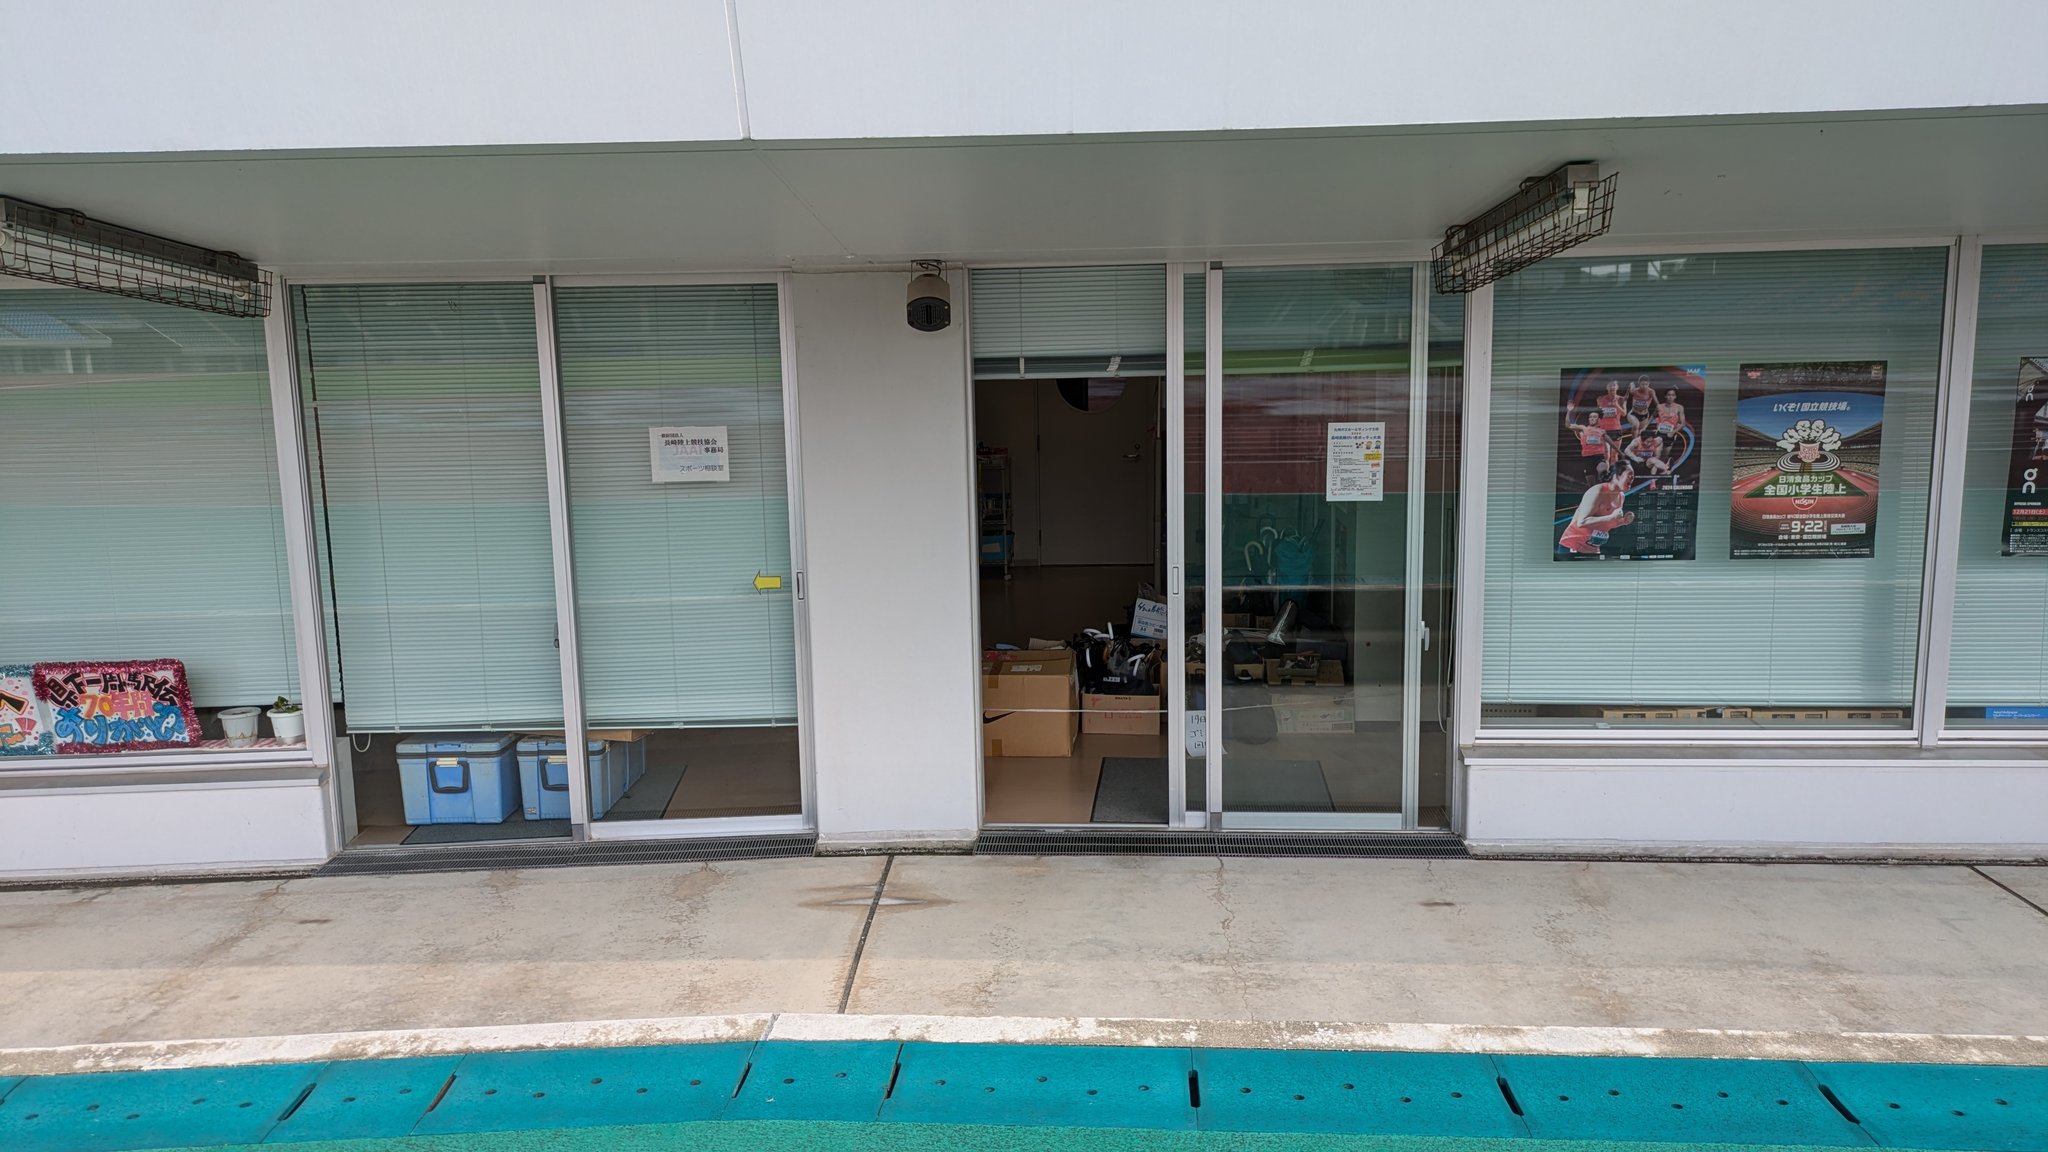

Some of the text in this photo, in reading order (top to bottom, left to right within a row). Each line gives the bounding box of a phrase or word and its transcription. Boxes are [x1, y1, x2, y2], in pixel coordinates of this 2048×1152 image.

[680, 464, 724, 472] スポーツ相談室
[1779, 475, 1833, 484] 日清食品カップ
[1764, 484, 1846, 496] 全国小学生陸上
